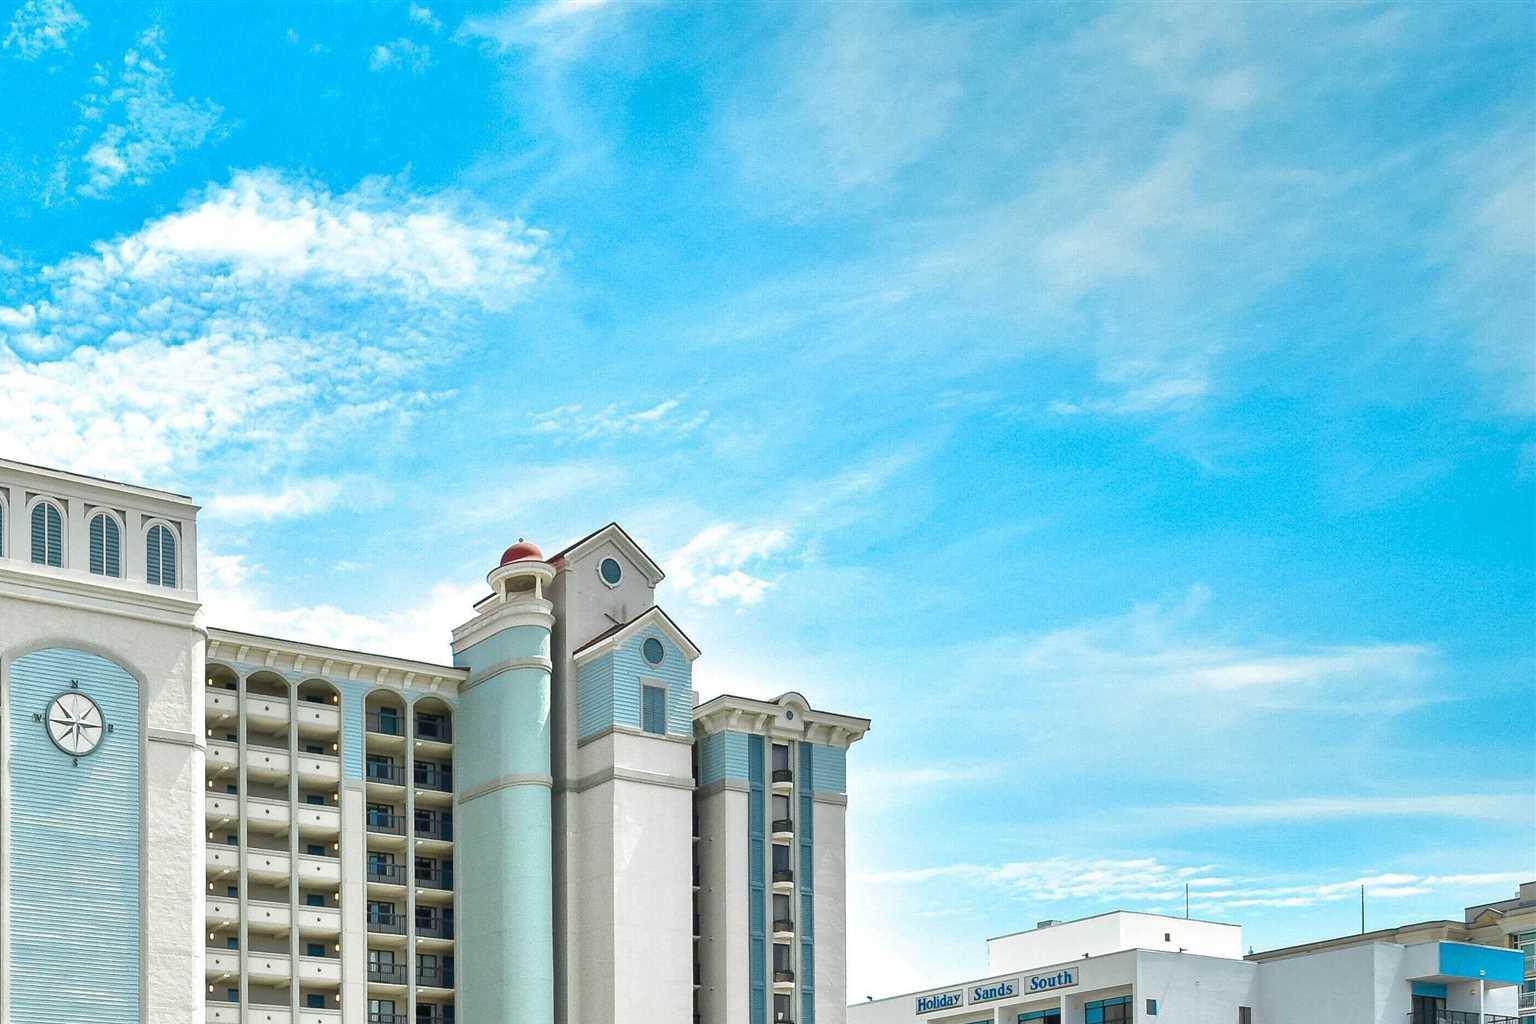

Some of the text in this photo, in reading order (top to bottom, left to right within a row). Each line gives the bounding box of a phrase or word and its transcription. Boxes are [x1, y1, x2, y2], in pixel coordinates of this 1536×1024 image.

[71, 680, 79, 689] N
[72, 758, 79, 767] S
[918, 971, 1073, 1012] Holiday Sands South
